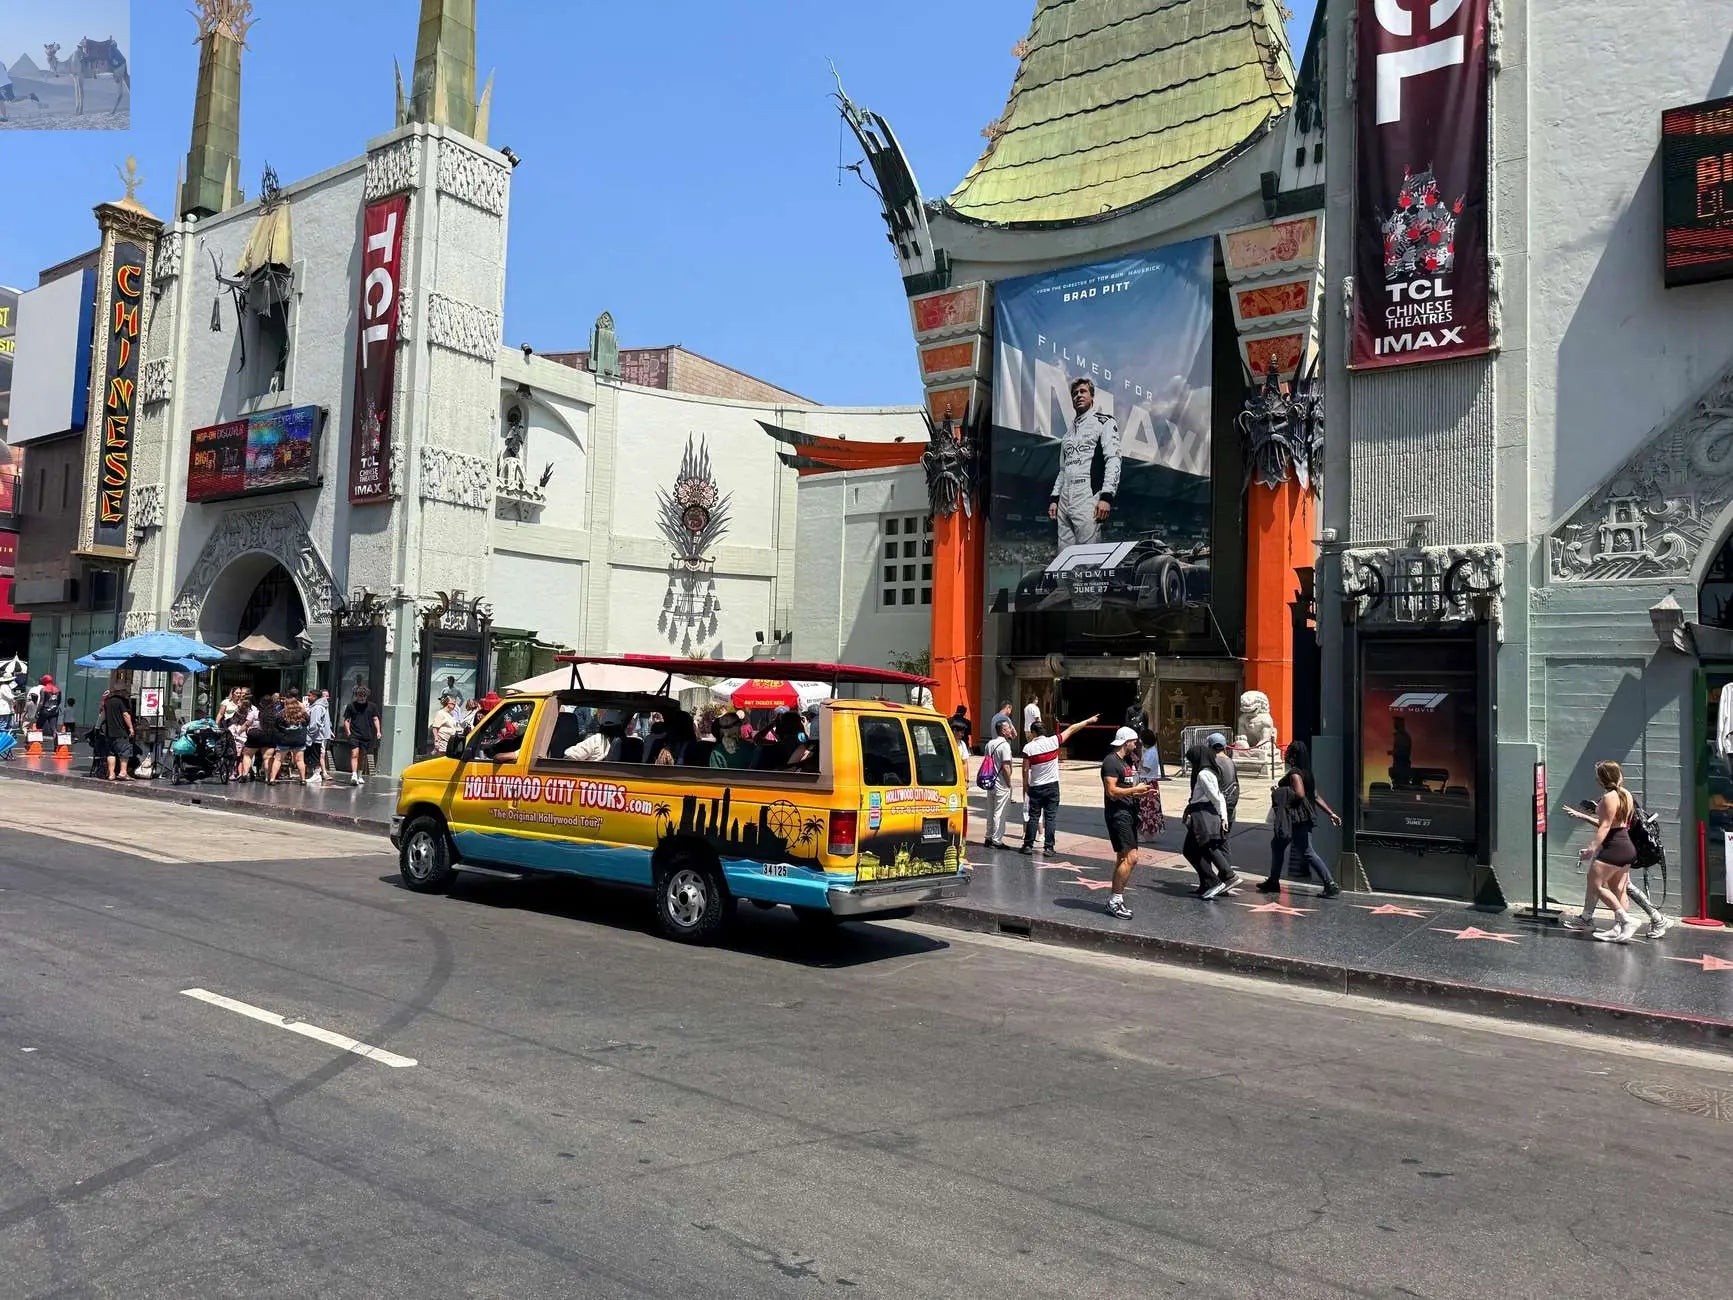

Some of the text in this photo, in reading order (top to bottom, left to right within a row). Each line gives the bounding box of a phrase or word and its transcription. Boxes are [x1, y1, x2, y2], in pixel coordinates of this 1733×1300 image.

[363, 212, 397, 369] TCL
[1063, 281, 1130, 302] BRAD PITT
[1385, 278, 1453, 302] TCL
[1385, 299, 1453, 319] CHINESE
[1385, 311, 1453, 330] THEATRES
[1375, 326, 1464, 355] IMAX
[1038, 334, 1153, 402] FILMED FOR
[101, 264, 141, 522] CHINESE
[360, 455, 379, 469] TCL
[354, 483, 383, 496] IMAX
[1044, 569, 1116, 580] THE MOVIE
[1073, 586, 1095, 594] JUNE
[463, 775, 541, 800] HOLLYWOOD
[545, 778, 577, 805] CITY
[885, 788, 914, 804] HOLLYWOOD
[509, 810, 537, 824] Original
[538, 813, 578, 828] Hollywood
[763, 864, 788, 877] 34125
